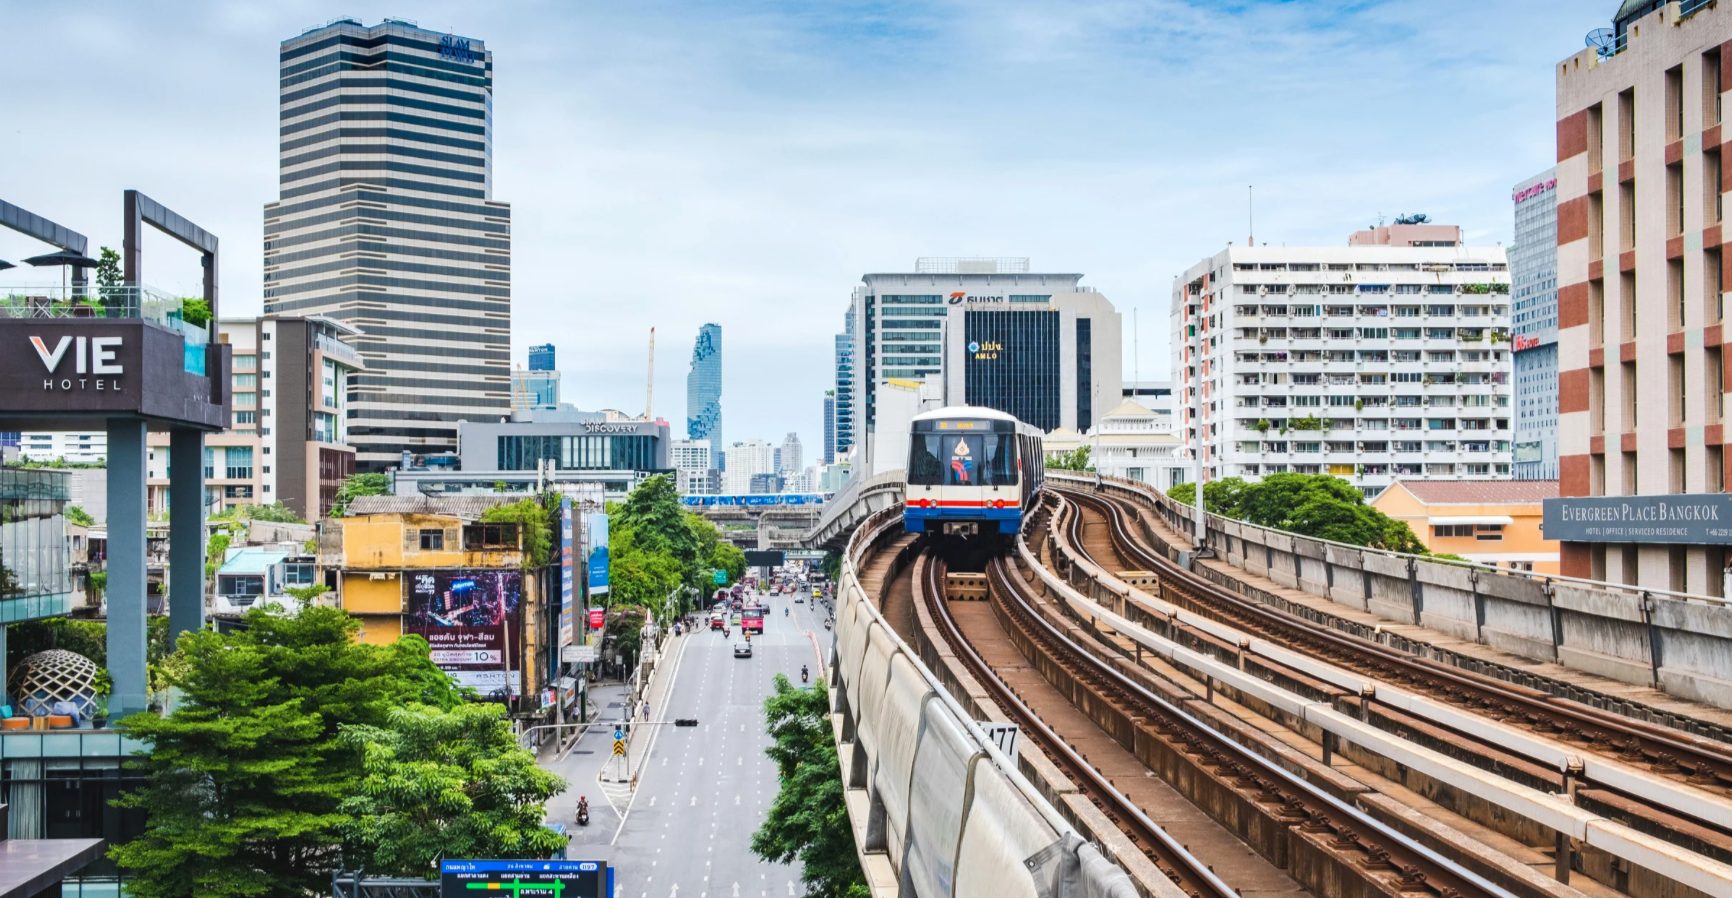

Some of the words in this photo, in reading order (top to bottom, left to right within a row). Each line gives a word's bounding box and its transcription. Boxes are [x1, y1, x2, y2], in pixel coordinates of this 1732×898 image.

[442, 36, 470, 49] SIAM
[29, 336, 124, 374] VIE
[43, 379, 121, 390] HOTEL
[585, 424, 638, 433] DISCOVERY
[1585, 527, 1601, 535] HOTEL
[1605, 527, 1624, 536] OFFICE
[1628, 527, 1654, 536] SERVICED
[1655, 527, 1688, 536] RESIDENCE
[474, 652, 489, 661] 10
